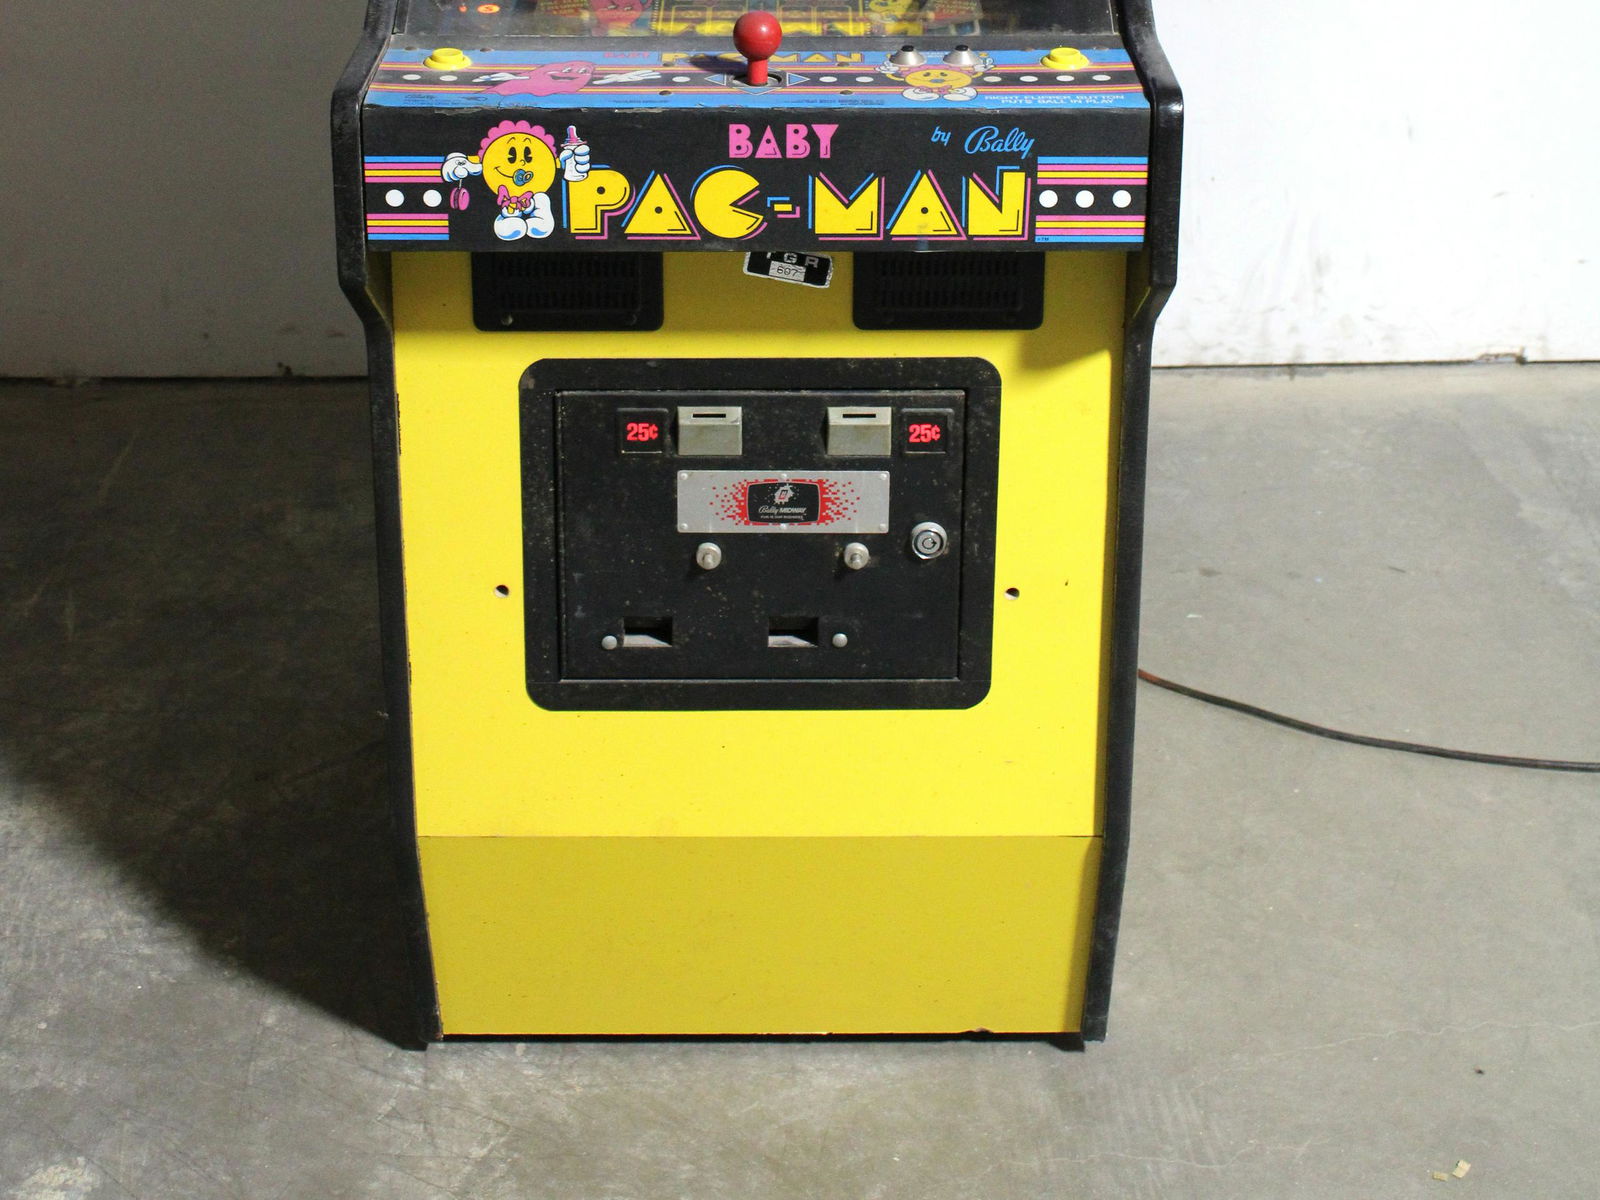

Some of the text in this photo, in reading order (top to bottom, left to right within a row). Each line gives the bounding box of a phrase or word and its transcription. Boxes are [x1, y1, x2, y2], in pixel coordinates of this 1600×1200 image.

[728, 123, 840, 159] BABY
[931, 125, 1035, 160] by Bally
[562, 164, 1032, 240] PAC-MAN
[626, 422, 658, 441] 25¢
[908, 424, 941, 443] 25¢
